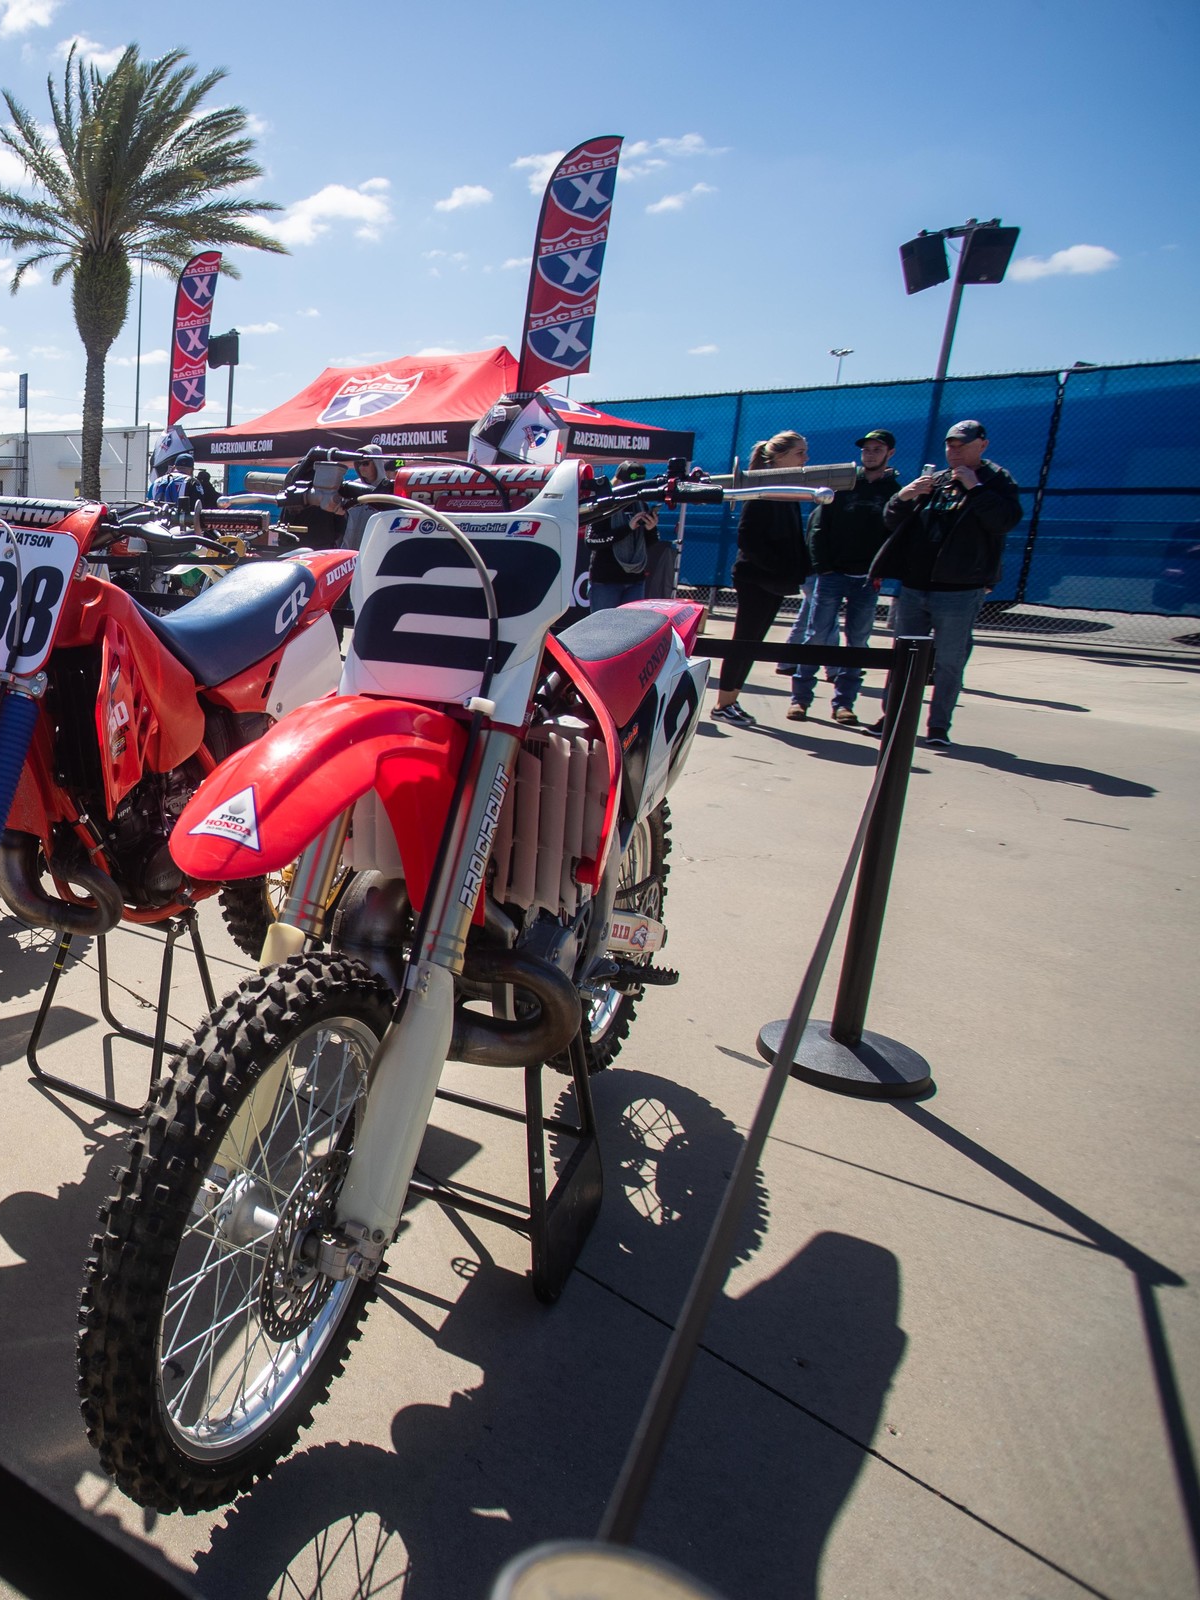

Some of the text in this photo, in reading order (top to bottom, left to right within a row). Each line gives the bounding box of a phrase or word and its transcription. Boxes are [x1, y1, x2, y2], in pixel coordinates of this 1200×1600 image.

[556, 155, 617, 177] RACER
[569, 172, 609, 211] X
[541, 231, 606, 254] RACER
[184, 265, 218, 276] RACER
[557, 248, 599, 285] X
[192, 276, 212, 300] X
[177, 317, 210, 328] RACER
[531, 304, 595, 329] RACER
[185, 327, 205, 352] X
[547, 320, 588, 359] X
[173, 368, 205, 380] RACER
[181, 378, 204, 402] X
[343, 383, 410, 394] RACER
[210, 439, 273, 454] RACERXONLINE.COM
[371, 430, 448, 446] @RACERXONLINE
[573, 431, 650, 450] RACERXONLINE.COM
[407, 466, 557, 486] RENTHA
[5, 531, 55, 549] WATSON
[275, 581, 311, 635] CR
[353, 537, 562, 675] 2
[638, 635, 670, 690] HONDA
[117, 806, 131, 819] HPP
[220, 814, 246, 825] PRO
[205, 819, 251, 837] HONDA
[459, 763, 510, 911] PRO CIRCUIT
